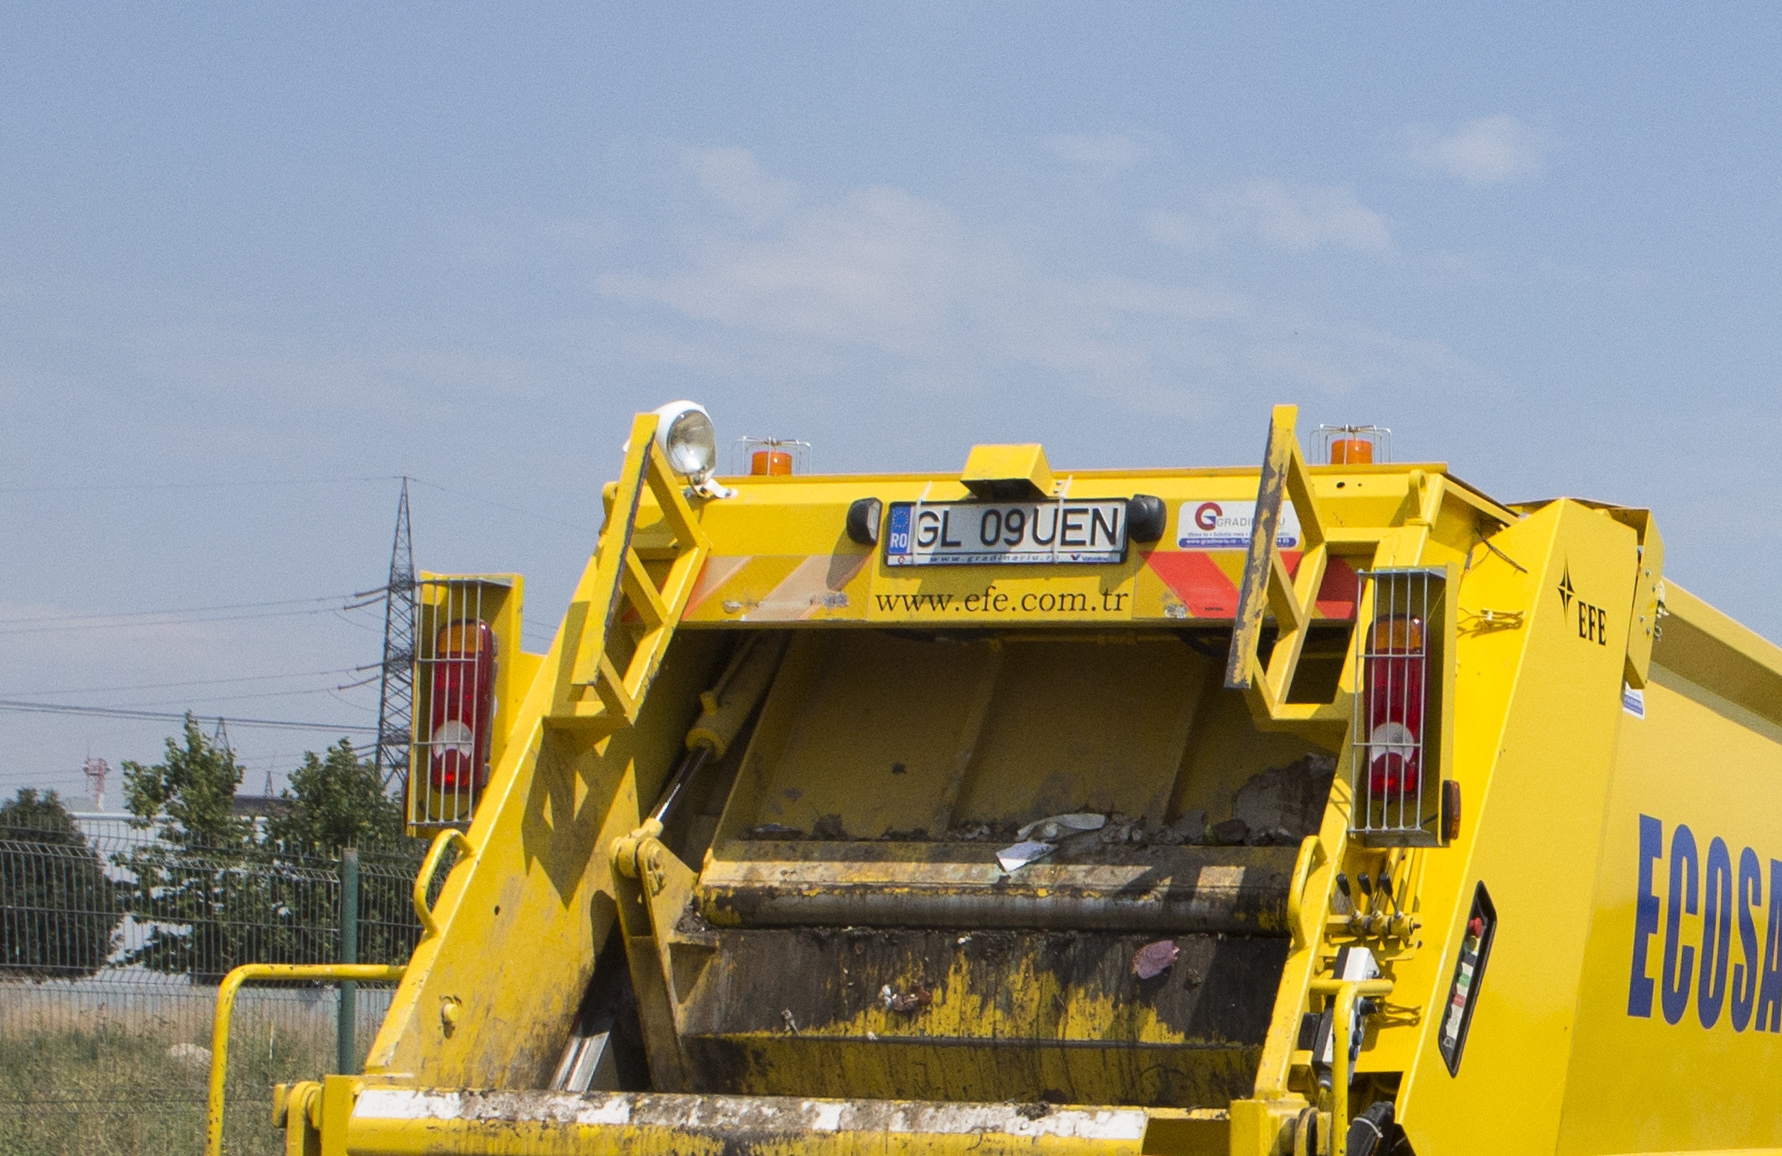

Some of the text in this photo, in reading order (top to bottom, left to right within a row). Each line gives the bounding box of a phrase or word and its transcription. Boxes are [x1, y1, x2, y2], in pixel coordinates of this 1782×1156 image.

[918, 510, 962, 547] GL
[1216, 517, 1286, 527] GRADIU
[889, 533, 908, 549] RO
[875, 586, 1129, 613] www.efe.com.tr
[1577, 600, 1607, 647] EFE
